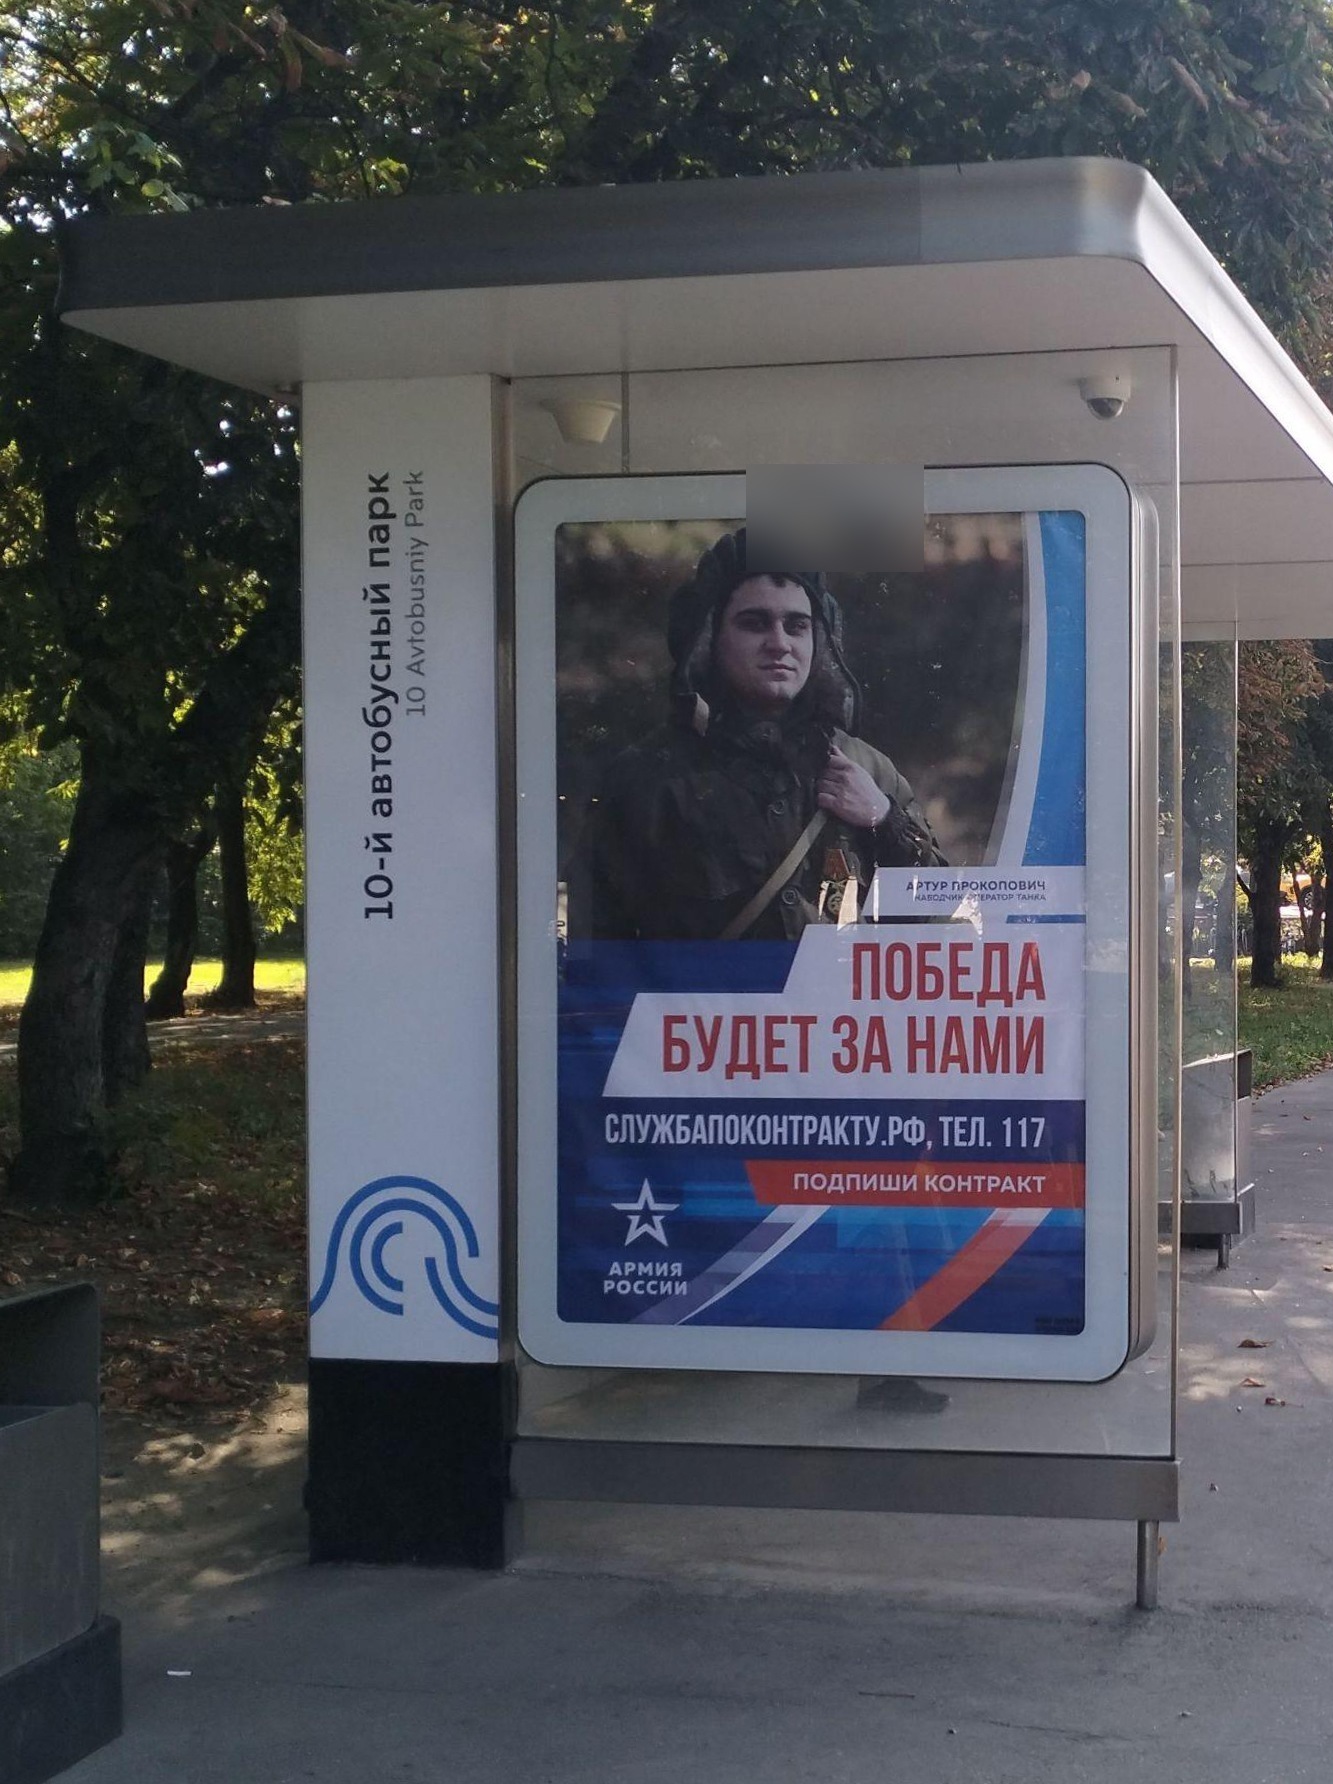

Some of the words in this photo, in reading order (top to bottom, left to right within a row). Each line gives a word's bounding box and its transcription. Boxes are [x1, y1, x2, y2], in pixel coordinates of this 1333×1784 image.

[367, 471, 397, 568] парк
[402, 469, 425, 528] Park
[403, 536, 430, 677] Avtobusniy
[361, 583, 399, 818] автобусный
[405, 686, 426, 717] 10
[362, 832, 395, 920] 10-й
[905, 880, 948, 892] АРТУР
[951, 880, 1046, 891] ПРОКОПОВИЧ
[1017, 893, 1047, 902] ТАНКА
[852, 942, 1046, 1007] ПОБЕДА
[662, 1014, 818, 1080] БУДЕТ
[832, 1015, 892, 1073] ЗА
[907, 1015, 1045, 1074] НАМИ
[605, 1113, 933, 1150] СЛУЖБАПОКОНТРАКТУ.РФ,
[939, 1116, 992, 1148] ТЕЛ.
[1002, 1117, 1045, 1148] 117
[793, 1173, 918, 1195] ПОДПИШИ
[925, 1174, 1046, 1193] КОНТРАКТ
[604, 1280, 687, 1295] РОССИИ
[609, 1262, 682, 1277] АРМИЯ
